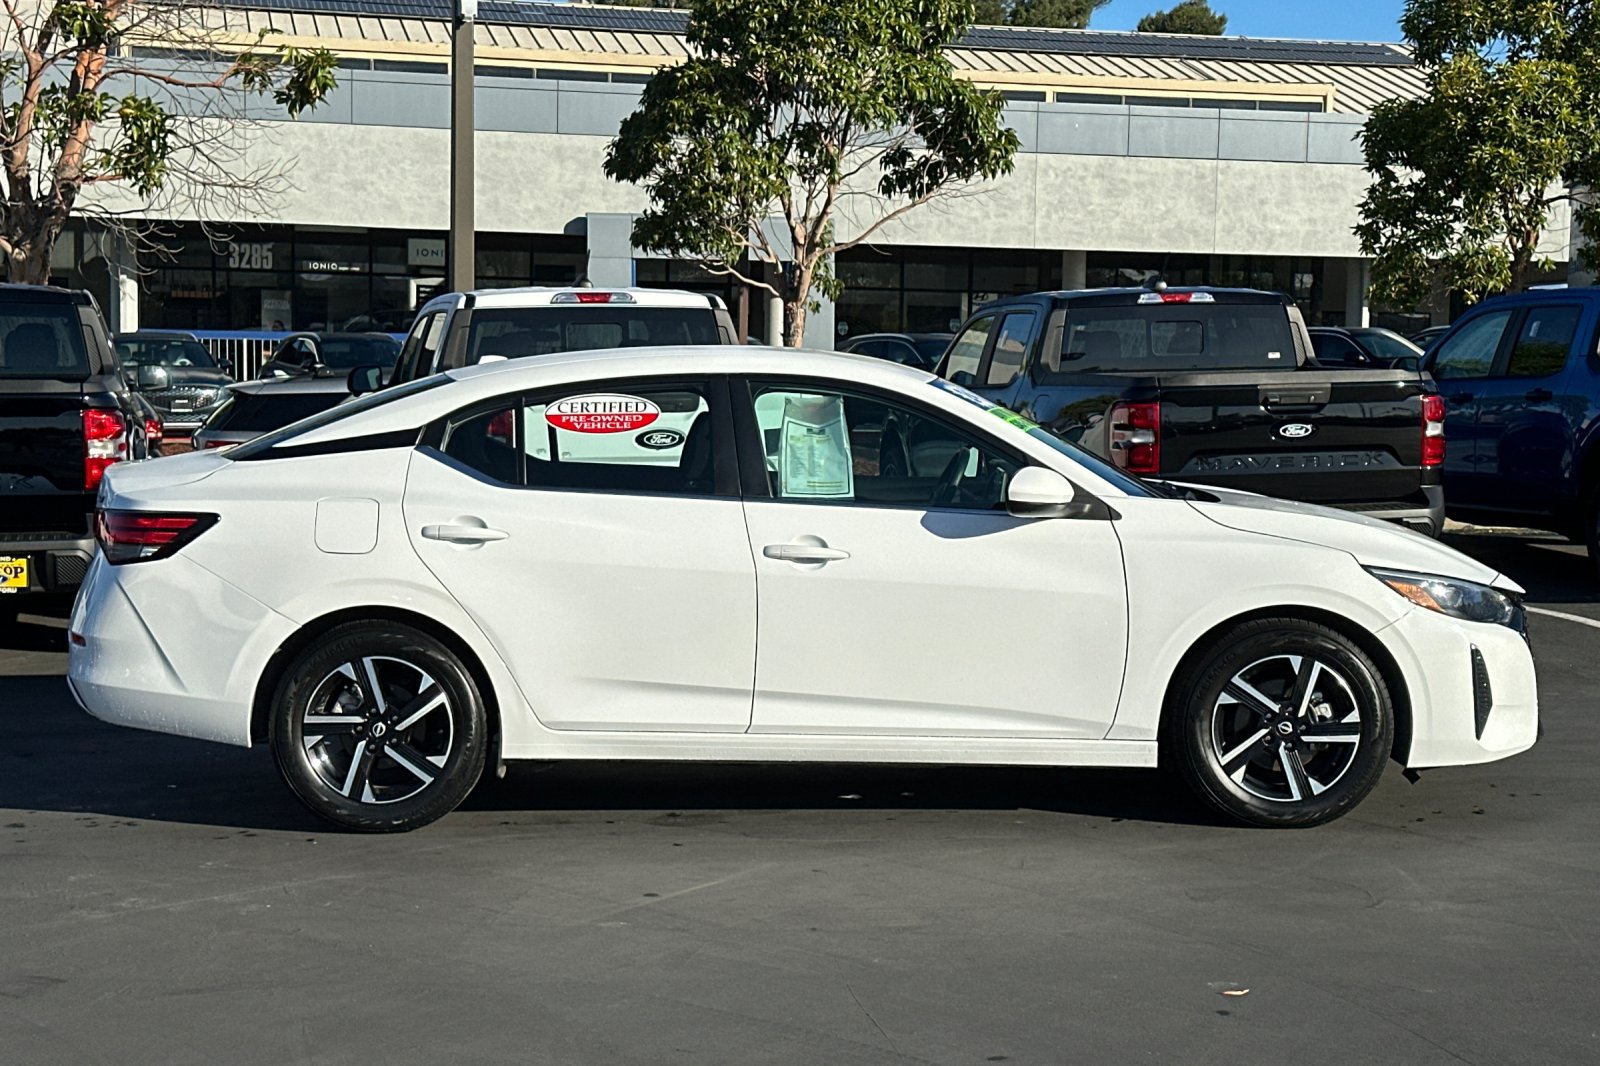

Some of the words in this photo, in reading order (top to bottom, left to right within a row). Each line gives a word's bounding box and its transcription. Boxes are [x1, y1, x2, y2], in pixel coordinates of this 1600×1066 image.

[229, 243, 273, 270] 3285
[557, 401, 648, 414] CERTIFIED
[561, 415, 643, 423] PRE-OWNED
[1195, 452, 1385, 472] MAVERICK
